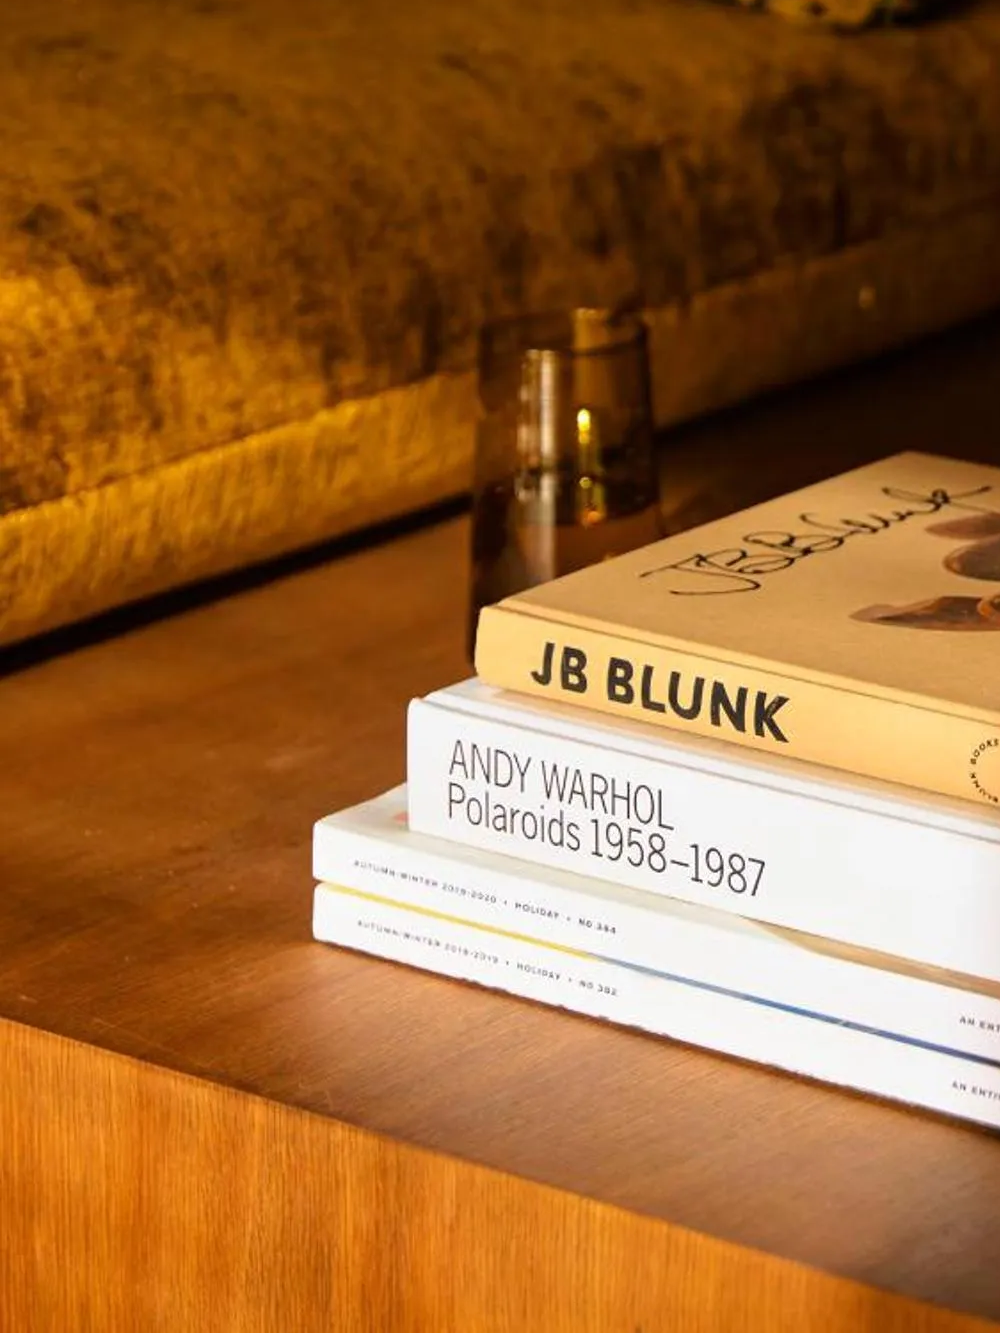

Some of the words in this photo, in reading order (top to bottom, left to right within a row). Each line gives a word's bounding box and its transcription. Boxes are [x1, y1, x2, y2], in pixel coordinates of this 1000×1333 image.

[531, 641, 589, 694] JB
[606, 656, 791, 744] BLUNK
[969, 737, 1000, 766] BOOKS
[449, 739, 532, 793] ANDY
[541, 759, 675, 832] WARHOL
[447, 782, 581, 852] Polaroids
[514, 901, 560, 921] HOLIDAY
[516, 962, 562, 982] HOLIDAY
[959, 1015, 976, 1027] AN
[951, 1080, 968, 1092] AN
